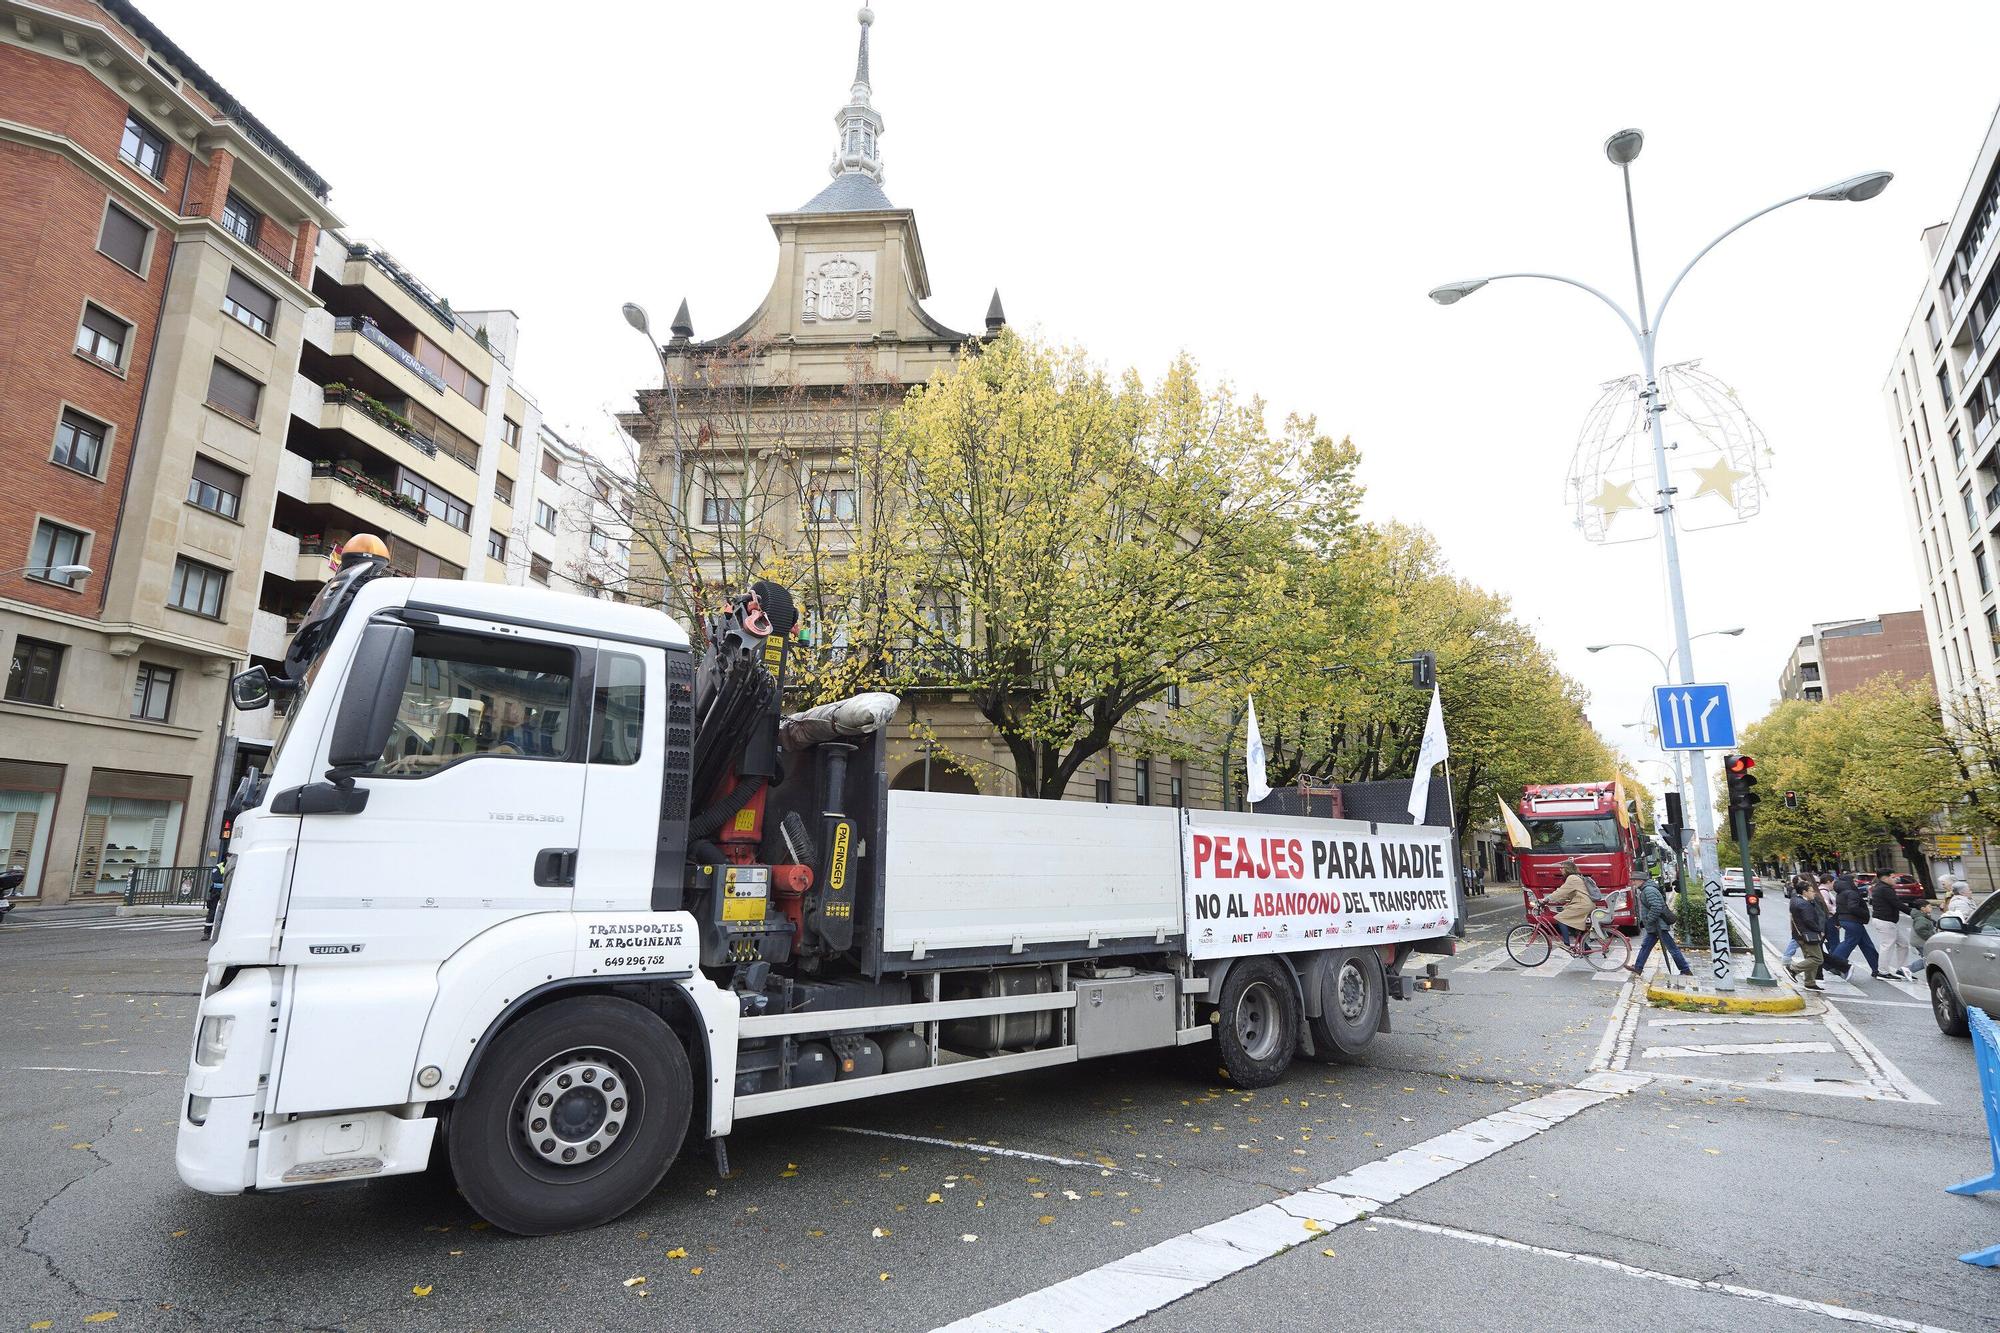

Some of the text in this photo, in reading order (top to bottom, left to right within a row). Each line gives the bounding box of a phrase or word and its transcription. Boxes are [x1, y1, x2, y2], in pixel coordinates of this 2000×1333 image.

[401, 351, 426, 375] VENDE
[833, 827, 847, 885] PALFINGER
[1193, 835, 1444, 880] PEAJES PARA NADIE
[1196, 889, 1449, 919] NO AL ABANDONO DEL TRANSPORTE
[589, 924, 684, 935] TRANSPORTES
[1231, 934, 1253, 943] ANET
[1304, 929, 1322, 938] ANET
[1366, 926, 1384, 934] ANET
[313, 944, 361, 954] EURO 6
[589, 939, 603, 949] M.
[605, 956, 665, 967] 649 296 752
